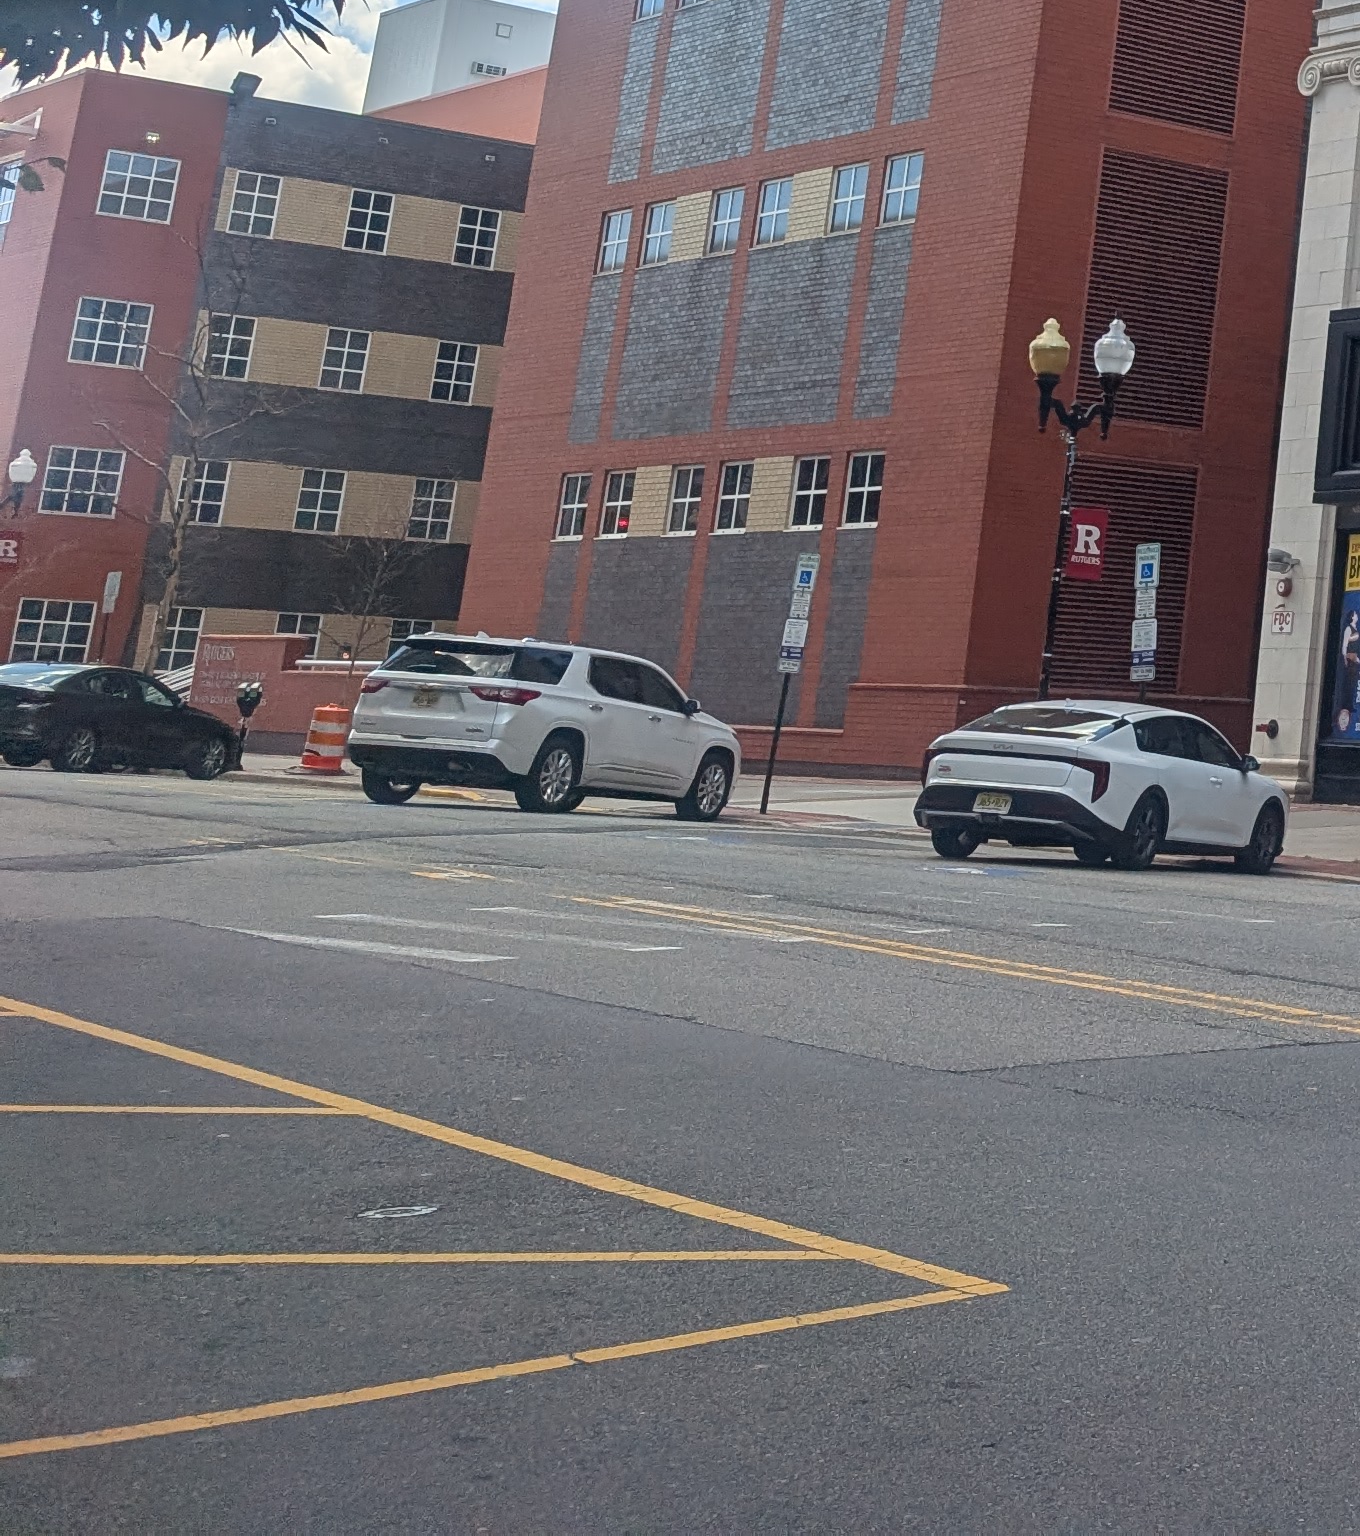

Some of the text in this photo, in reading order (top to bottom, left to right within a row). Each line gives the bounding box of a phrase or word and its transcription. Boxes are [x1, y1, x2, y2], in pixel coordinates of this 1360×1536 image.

[1074, 524, 1100, 555] R
[1071, 555, 1100, 565] RUTGERS
[1273, 612, 1291, 626] FDC
